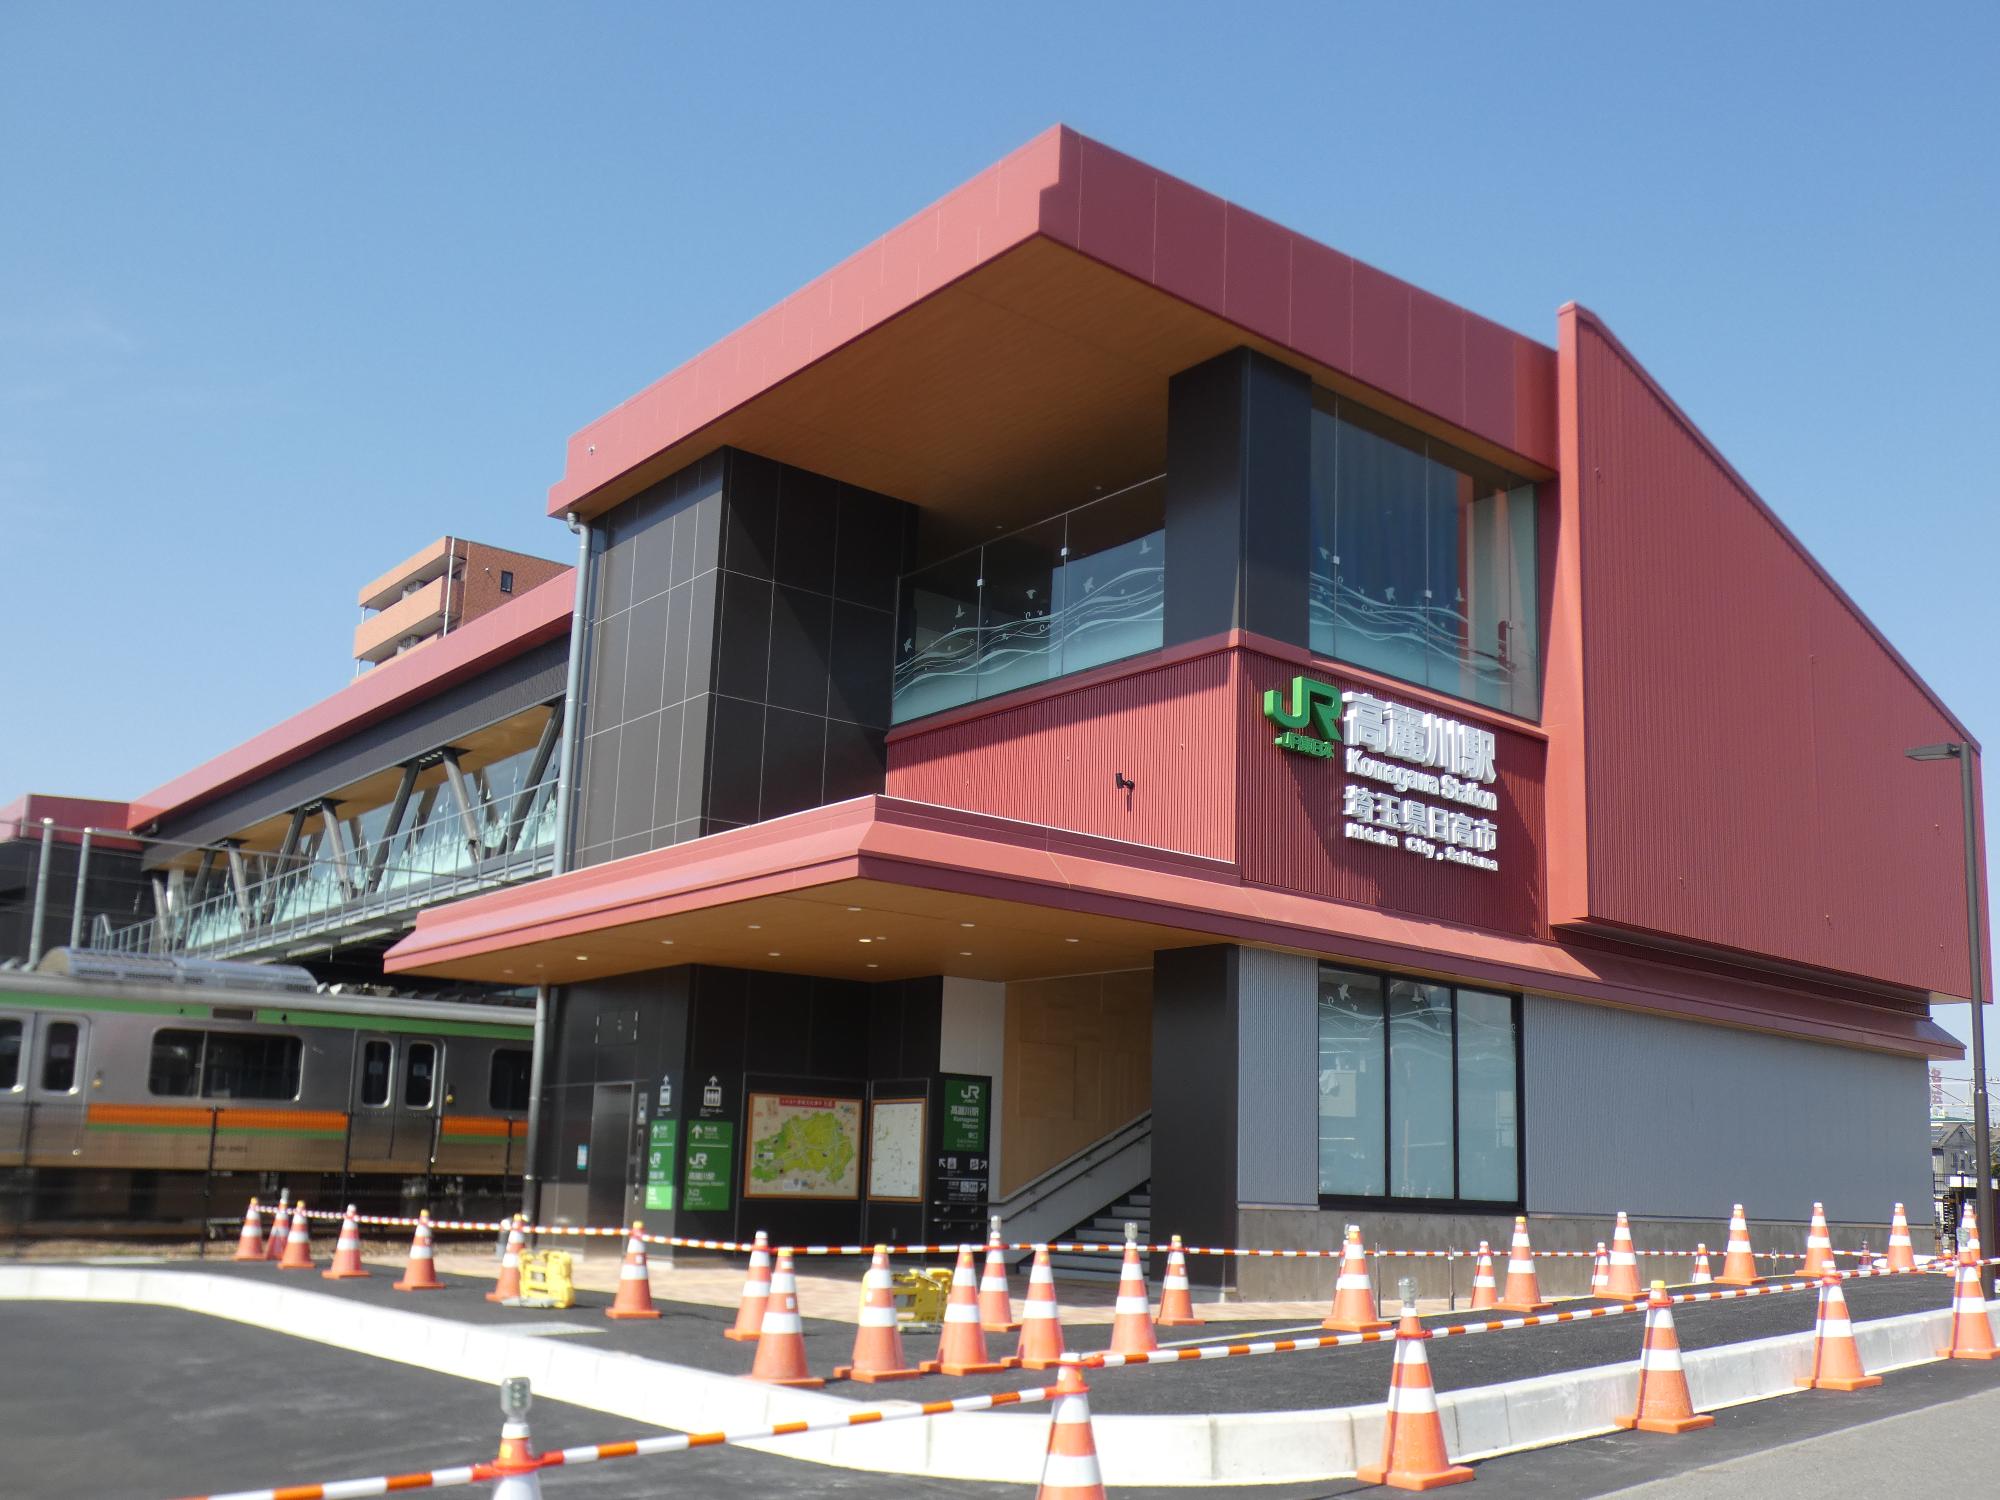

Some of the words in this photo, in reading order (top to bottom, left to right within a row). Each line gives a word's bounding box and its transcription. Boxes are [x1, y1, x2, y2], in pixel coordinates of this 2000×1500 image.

[1264, 676, 1342, 742] JR
[1342, 691, 1497, 784] 高麗川駅
[1346, 748, 1440, 796] Komagawa
[1440, 774, 1498, 811] Station
[1343, 785, 1498, 852] 埼玉県日高市
[1345, 822, 1399, 847] Hidaka
[961, 1085, 980, 1100] JR
[689, 1152, 707, 1166] JR
